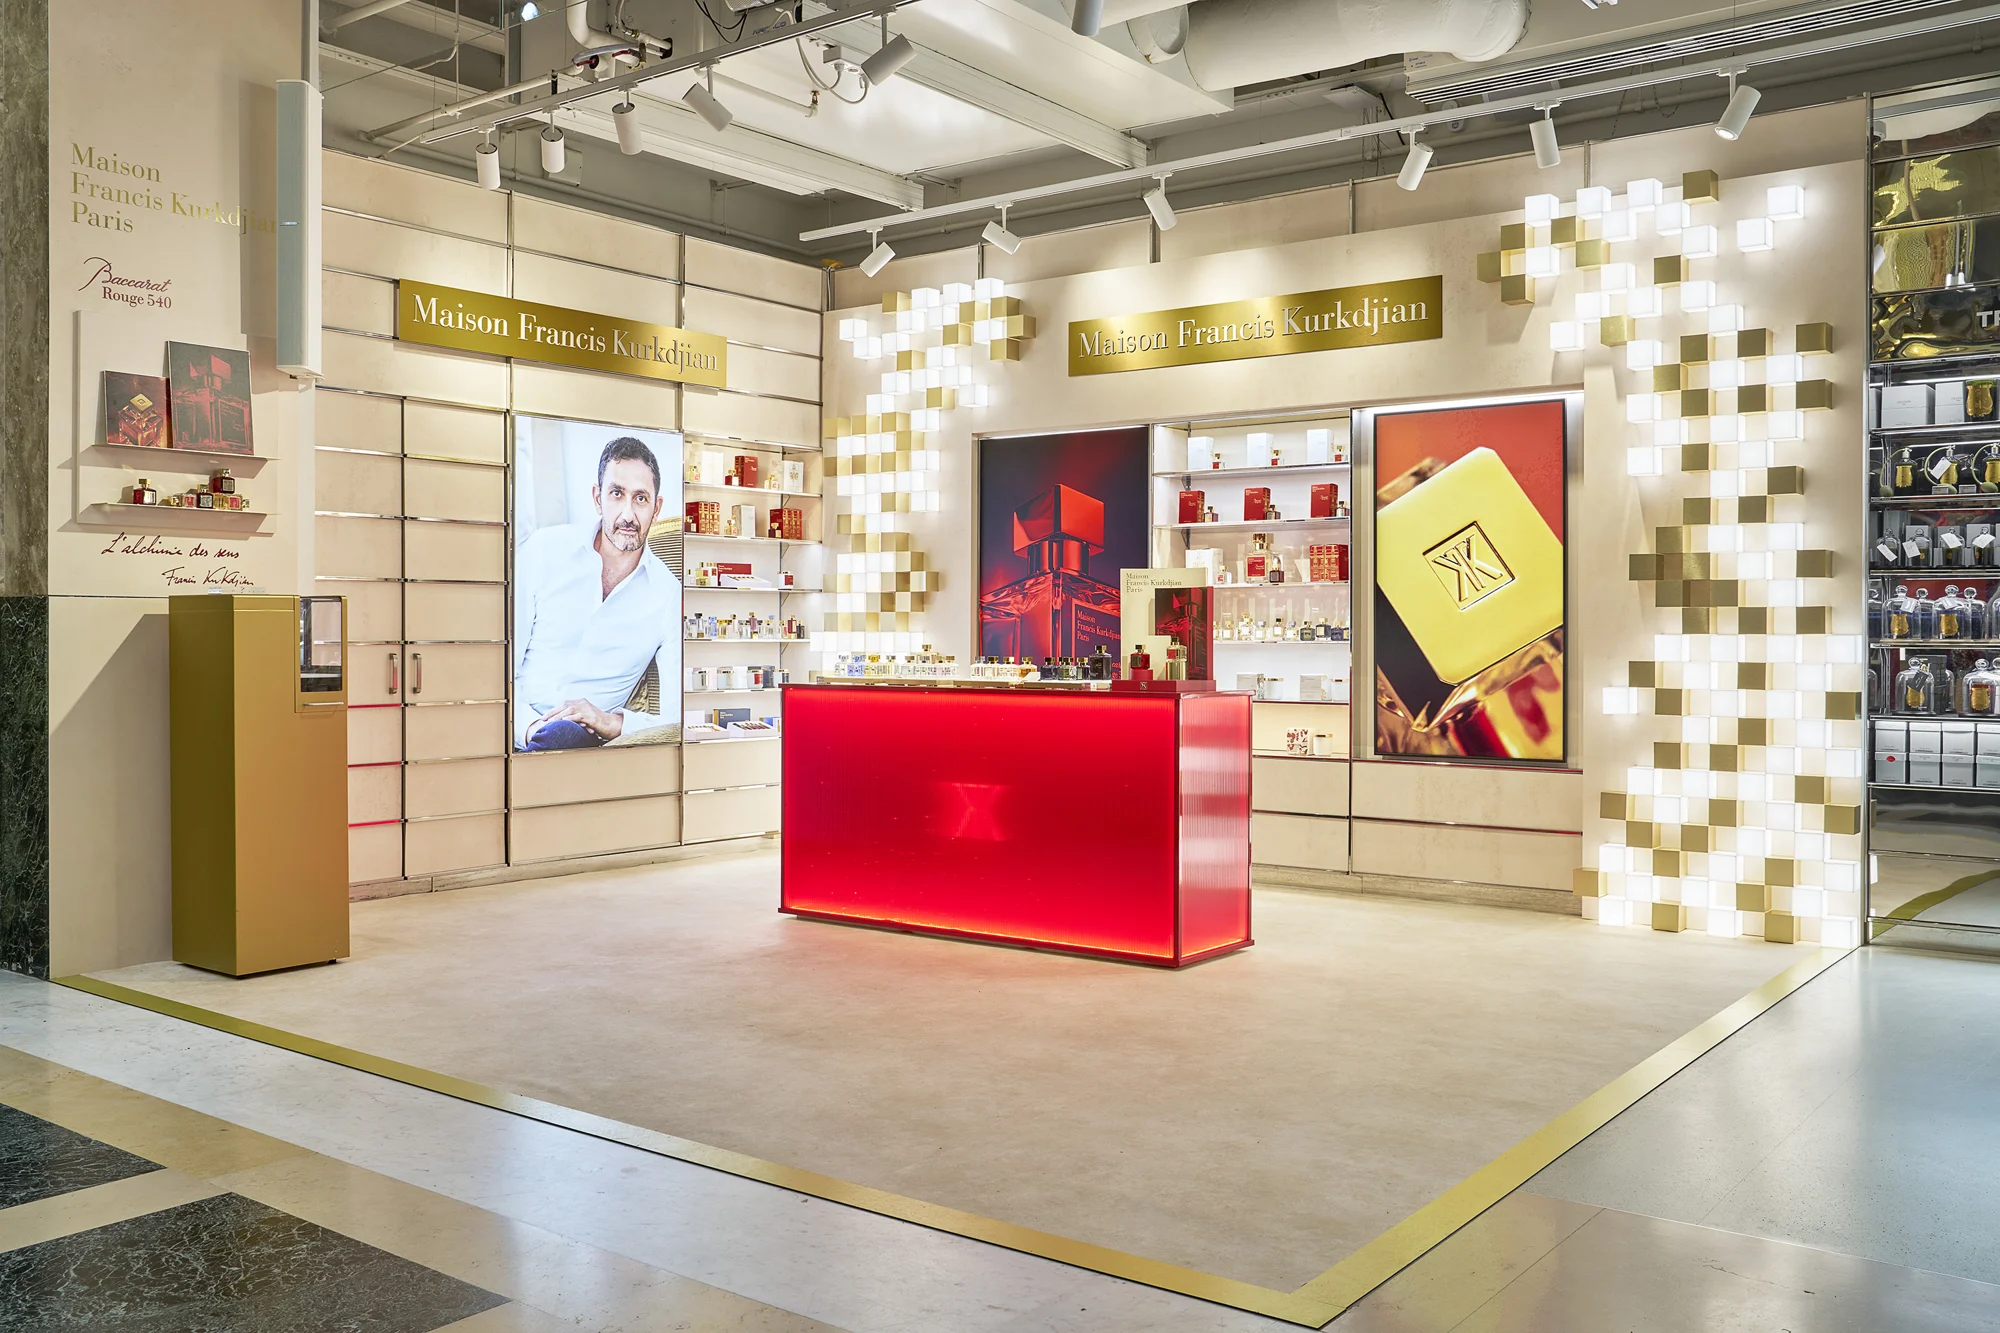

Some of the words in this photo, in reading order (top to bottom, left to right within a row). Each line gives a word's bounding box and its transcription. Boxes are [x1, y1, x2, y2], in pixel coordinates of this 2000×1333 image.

[71, 142, 162, 183] Maison
[71, 171, 163, 210] Francis
[71, 201, 134, 233] Paris
[78, 257, 172, 292] Baccarat
[102, 286, 144, 308] Rouge
[147, 294, 172, 309] 540
[412, 294, 509, 337] Maison
[517, 312, 607, 353] Francis
[612, 328, 718, 375] Kurkdjian
[1078, 330, 1169, 359] Maison
[1176, 313, 1275, 349] Francis
[1281, 297, 1429, 336] Kurkdjian
[189, 543, 209, 557] des
[213, 547, 240, 559] sens
[1150, 579, 1182, 587] Kurkdjian
[1077, 609, 1096, 623] Maison
[1077, 620, 1096, 634] Francis
[1077, 630, 1090, 642] Paris
